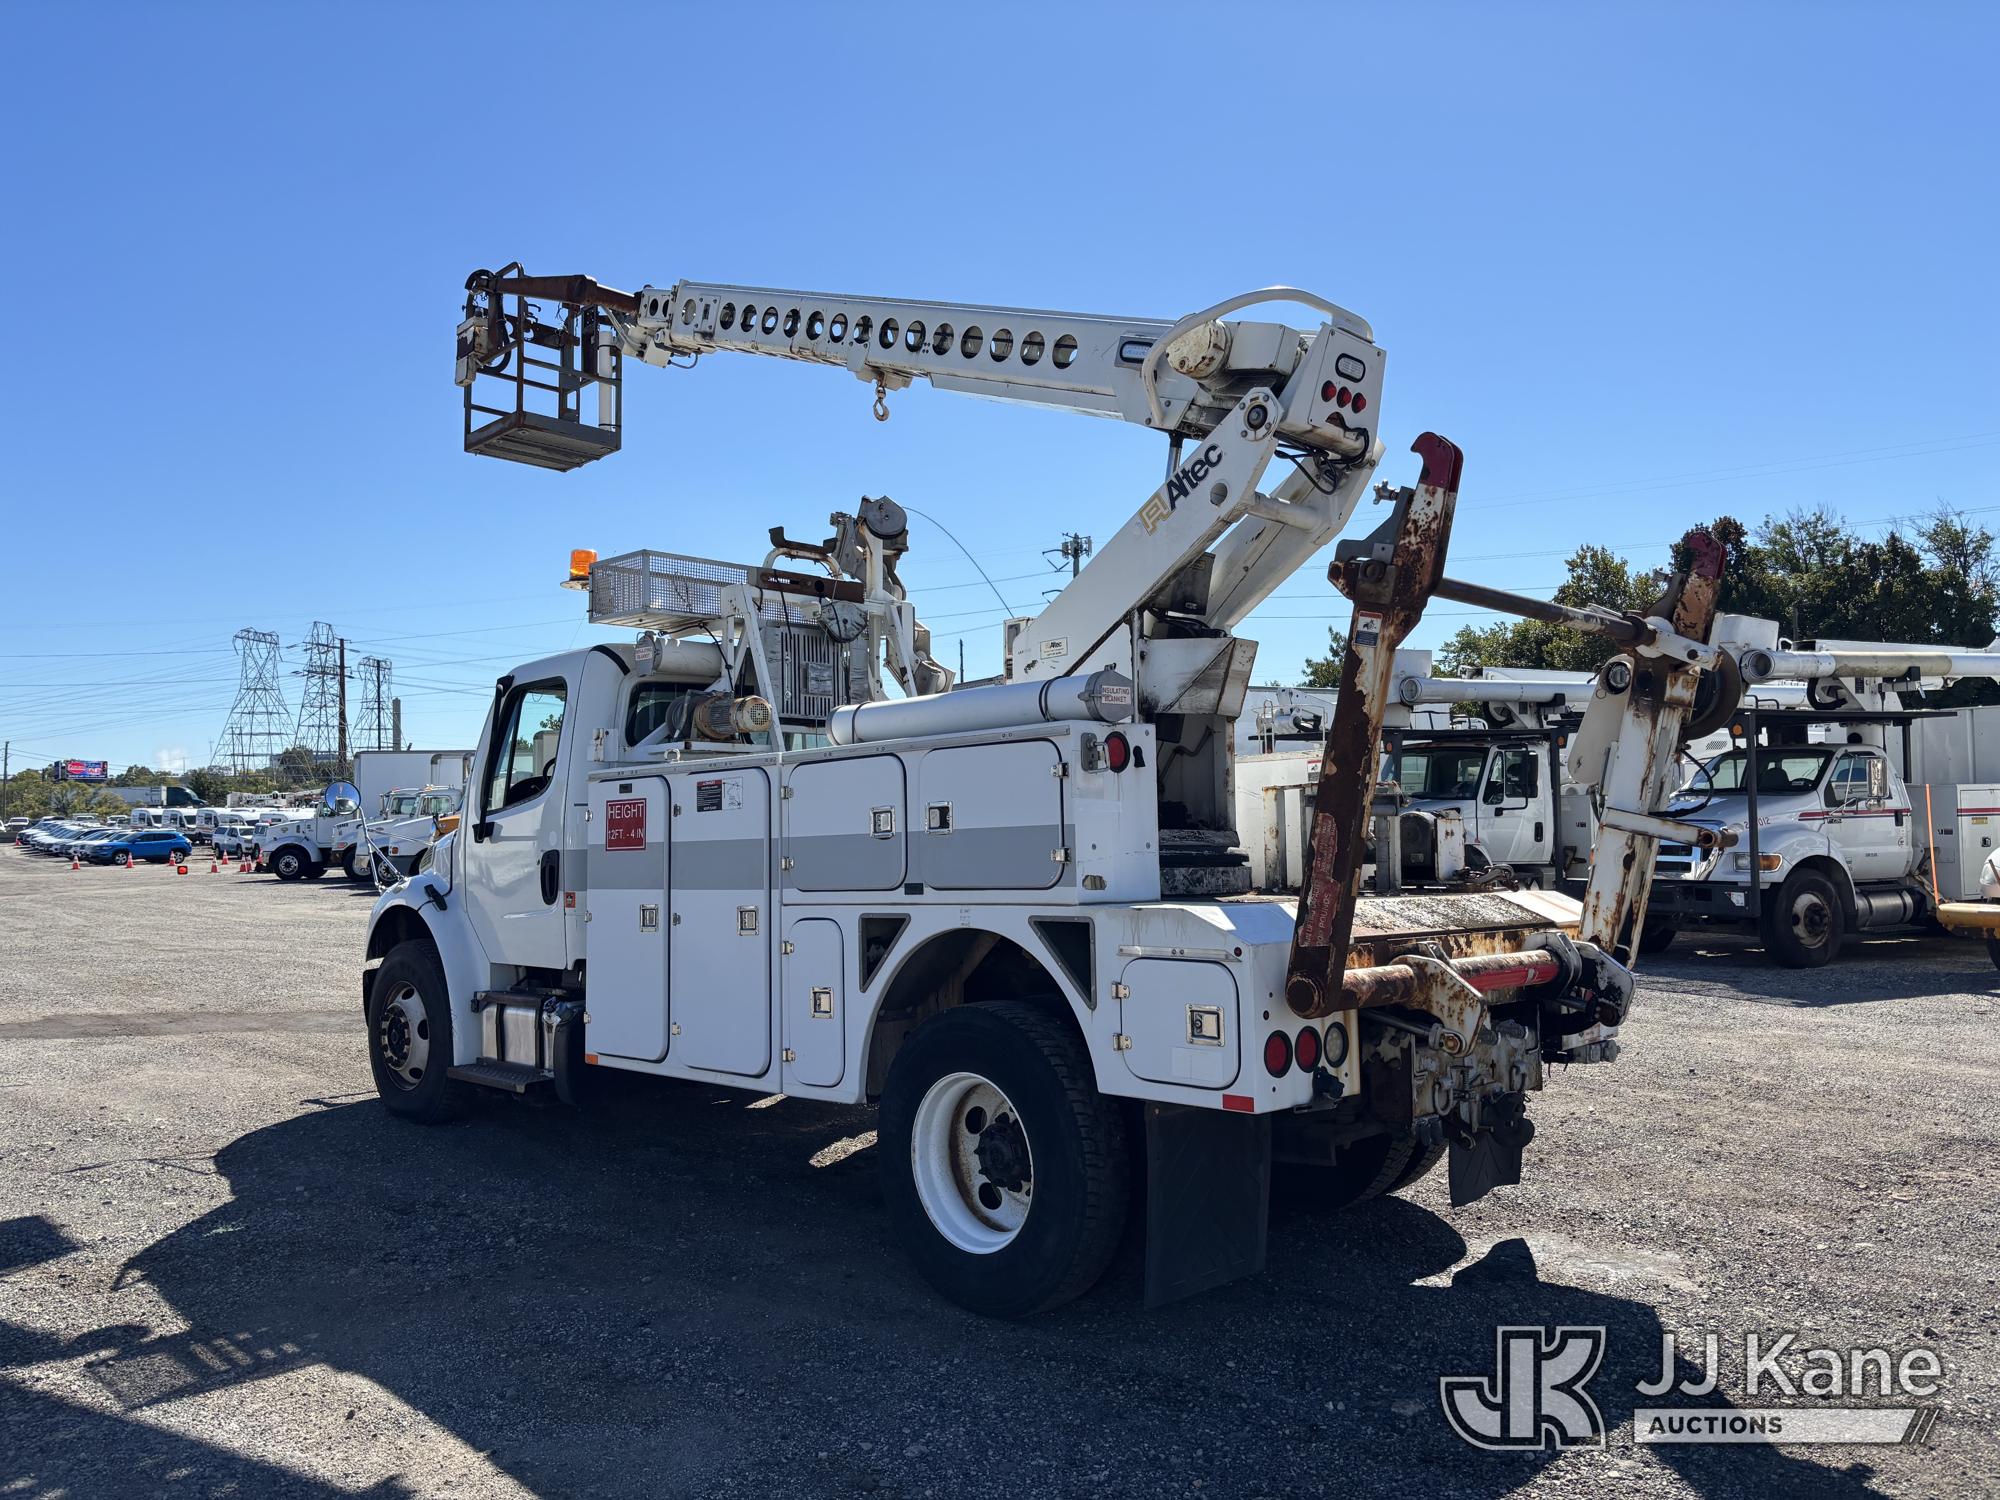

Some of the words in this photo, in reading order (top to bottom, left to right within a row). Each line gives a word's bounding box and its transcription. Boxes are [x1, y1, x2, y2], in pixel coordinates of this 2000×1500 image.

[1166, 445, 1222, 511] Altec
[1102, 687, 1130, 695] INSULATING
[1104, 695, 1127, 703] BLANKET
[608, 804, 644, 819] HEIGHT
[1319, 892, 1331, 929] POUNDS
